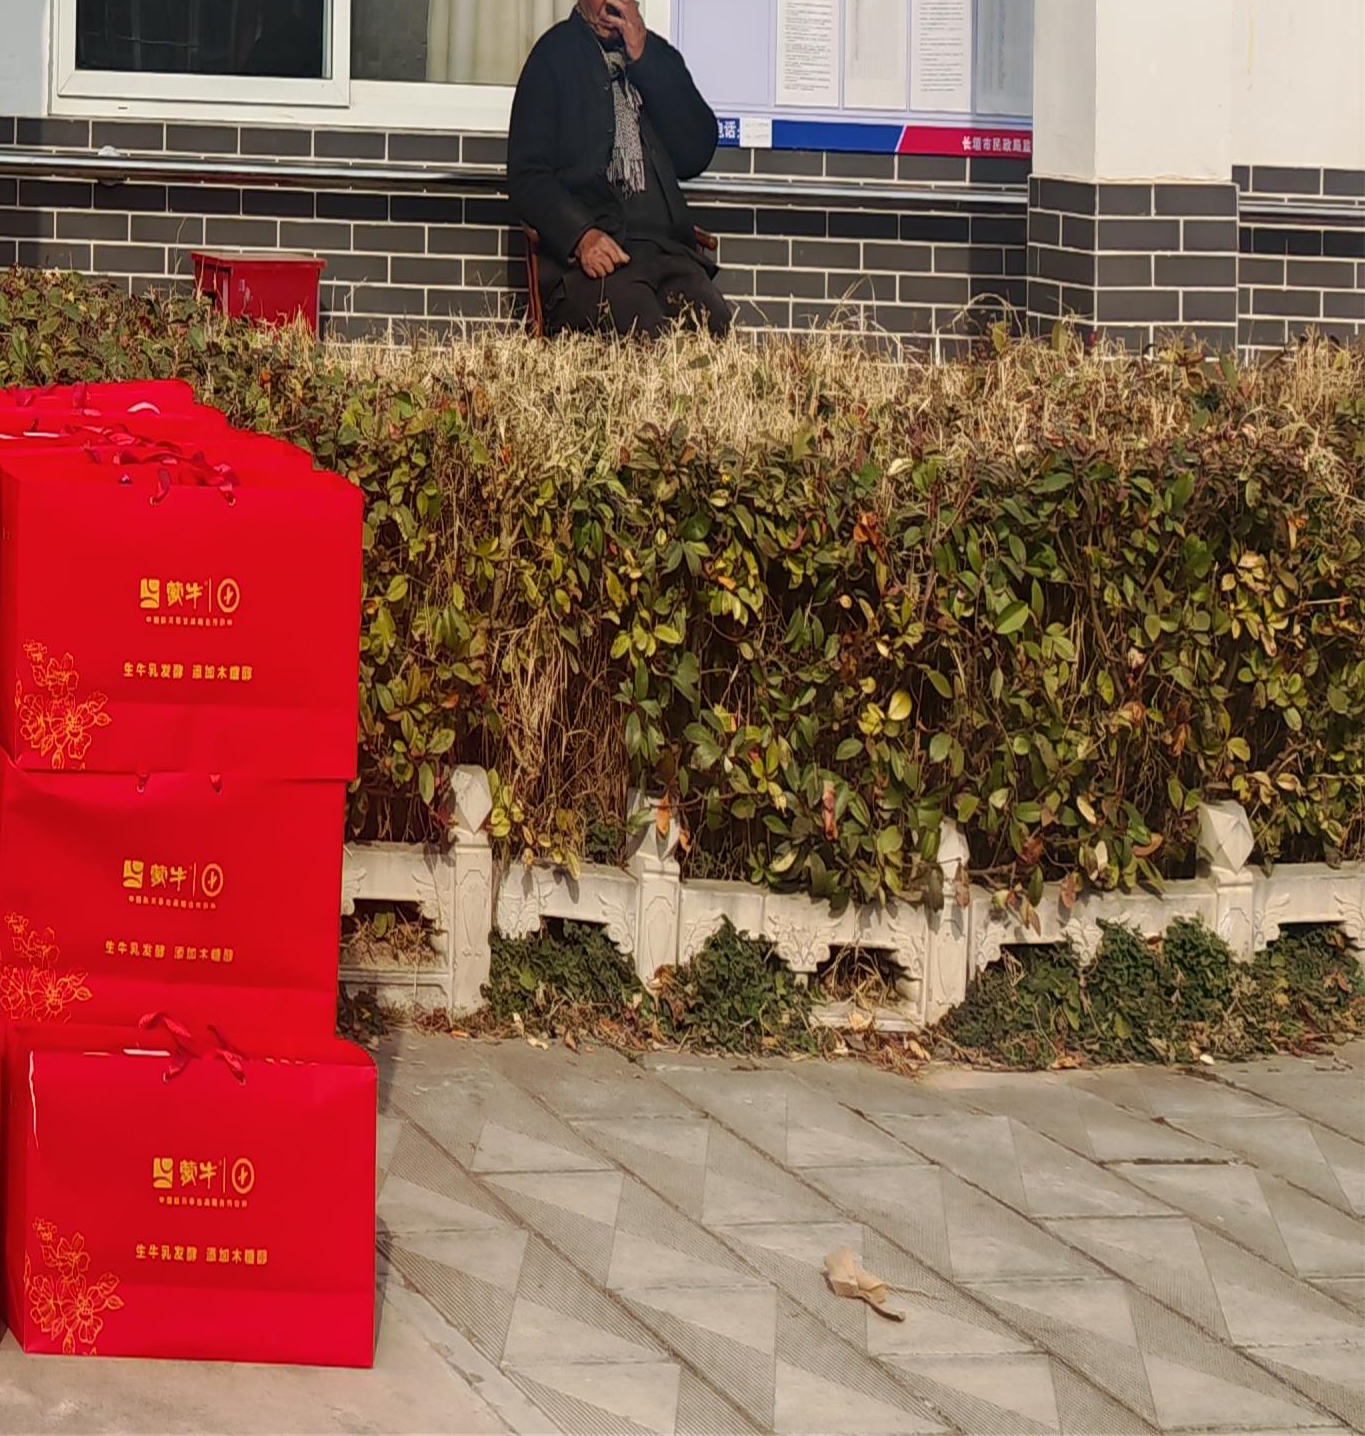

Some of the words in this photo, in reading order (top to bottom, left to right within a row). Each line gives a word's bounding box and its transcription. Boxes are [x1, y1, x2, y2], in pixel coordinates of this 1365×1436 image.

[167, 580, 203, 609] 蒙牛
[124, 662, 183, 678] 生牛乳发酵
[150, 864, 187, 892] 蒙牛
[105, 941, 165, 958] 生牛乳发酵
[180, 1160, 217, 1189] 蒙牛
[136, 1244, 197, 1261] 生牛乳发酵
